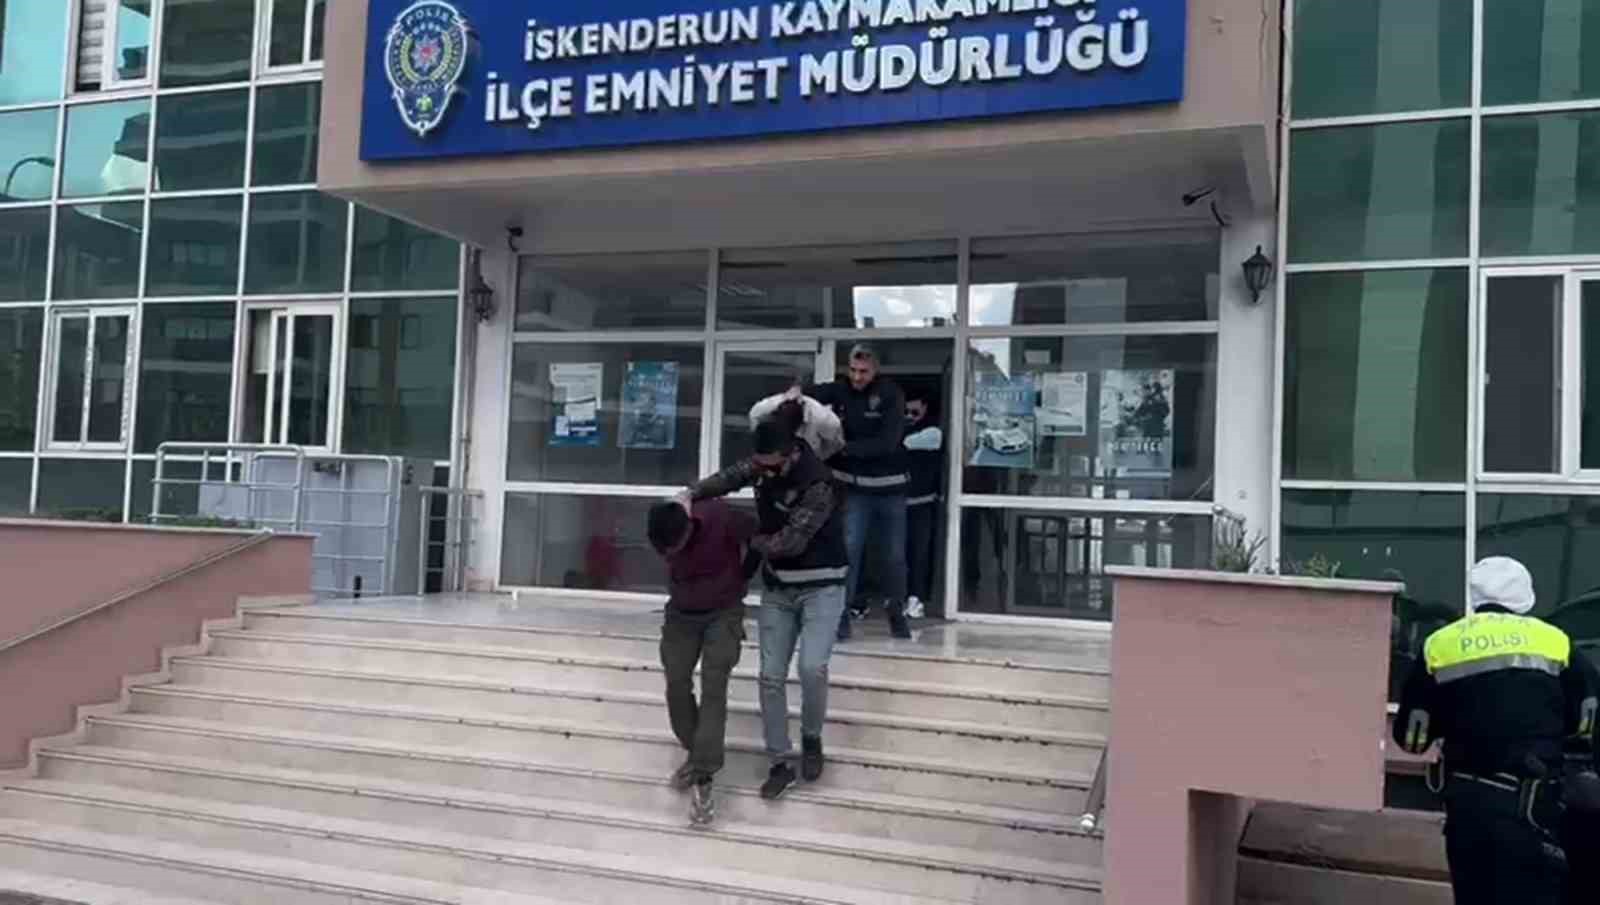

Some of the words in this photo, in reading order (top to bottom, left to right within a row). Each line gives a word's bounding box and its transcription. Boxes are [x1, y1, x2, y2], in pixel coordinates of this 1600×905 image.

[485, 72, 573, 129] İLÇE
[585, 56, 788, 113] EMNİYET
[799, 8, 1149, 96] MÜDÜRLÜĞÜ
[524, 6, 759, 61] İSKENDERUN
[771, 0, 1097, 38] KAYMAKAM
